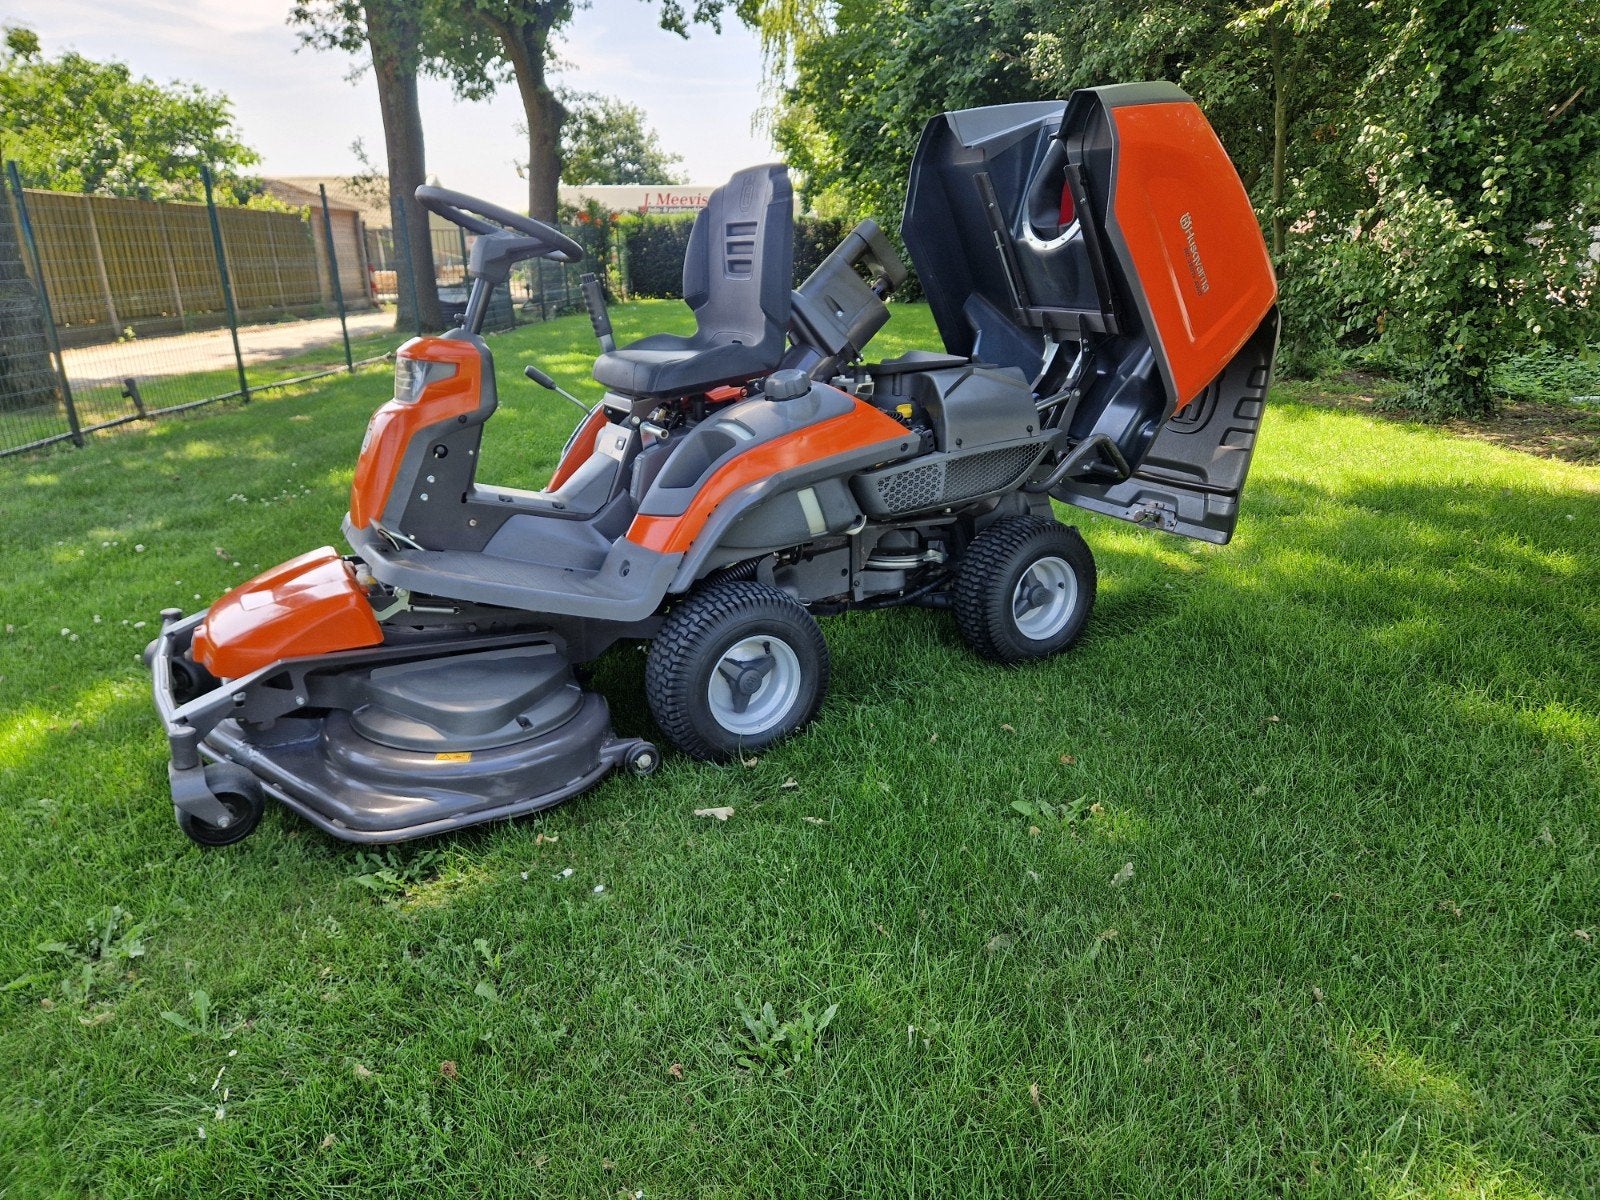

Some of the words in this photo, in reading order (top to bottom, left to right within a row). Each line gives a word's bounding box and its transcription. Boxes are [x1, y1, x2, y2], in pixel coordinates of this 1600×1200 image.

[643, 193, 651, 207] J.
[657, 193, 708, 205] Meevis
[1185, 226, 1209, 293] Husqvarna
